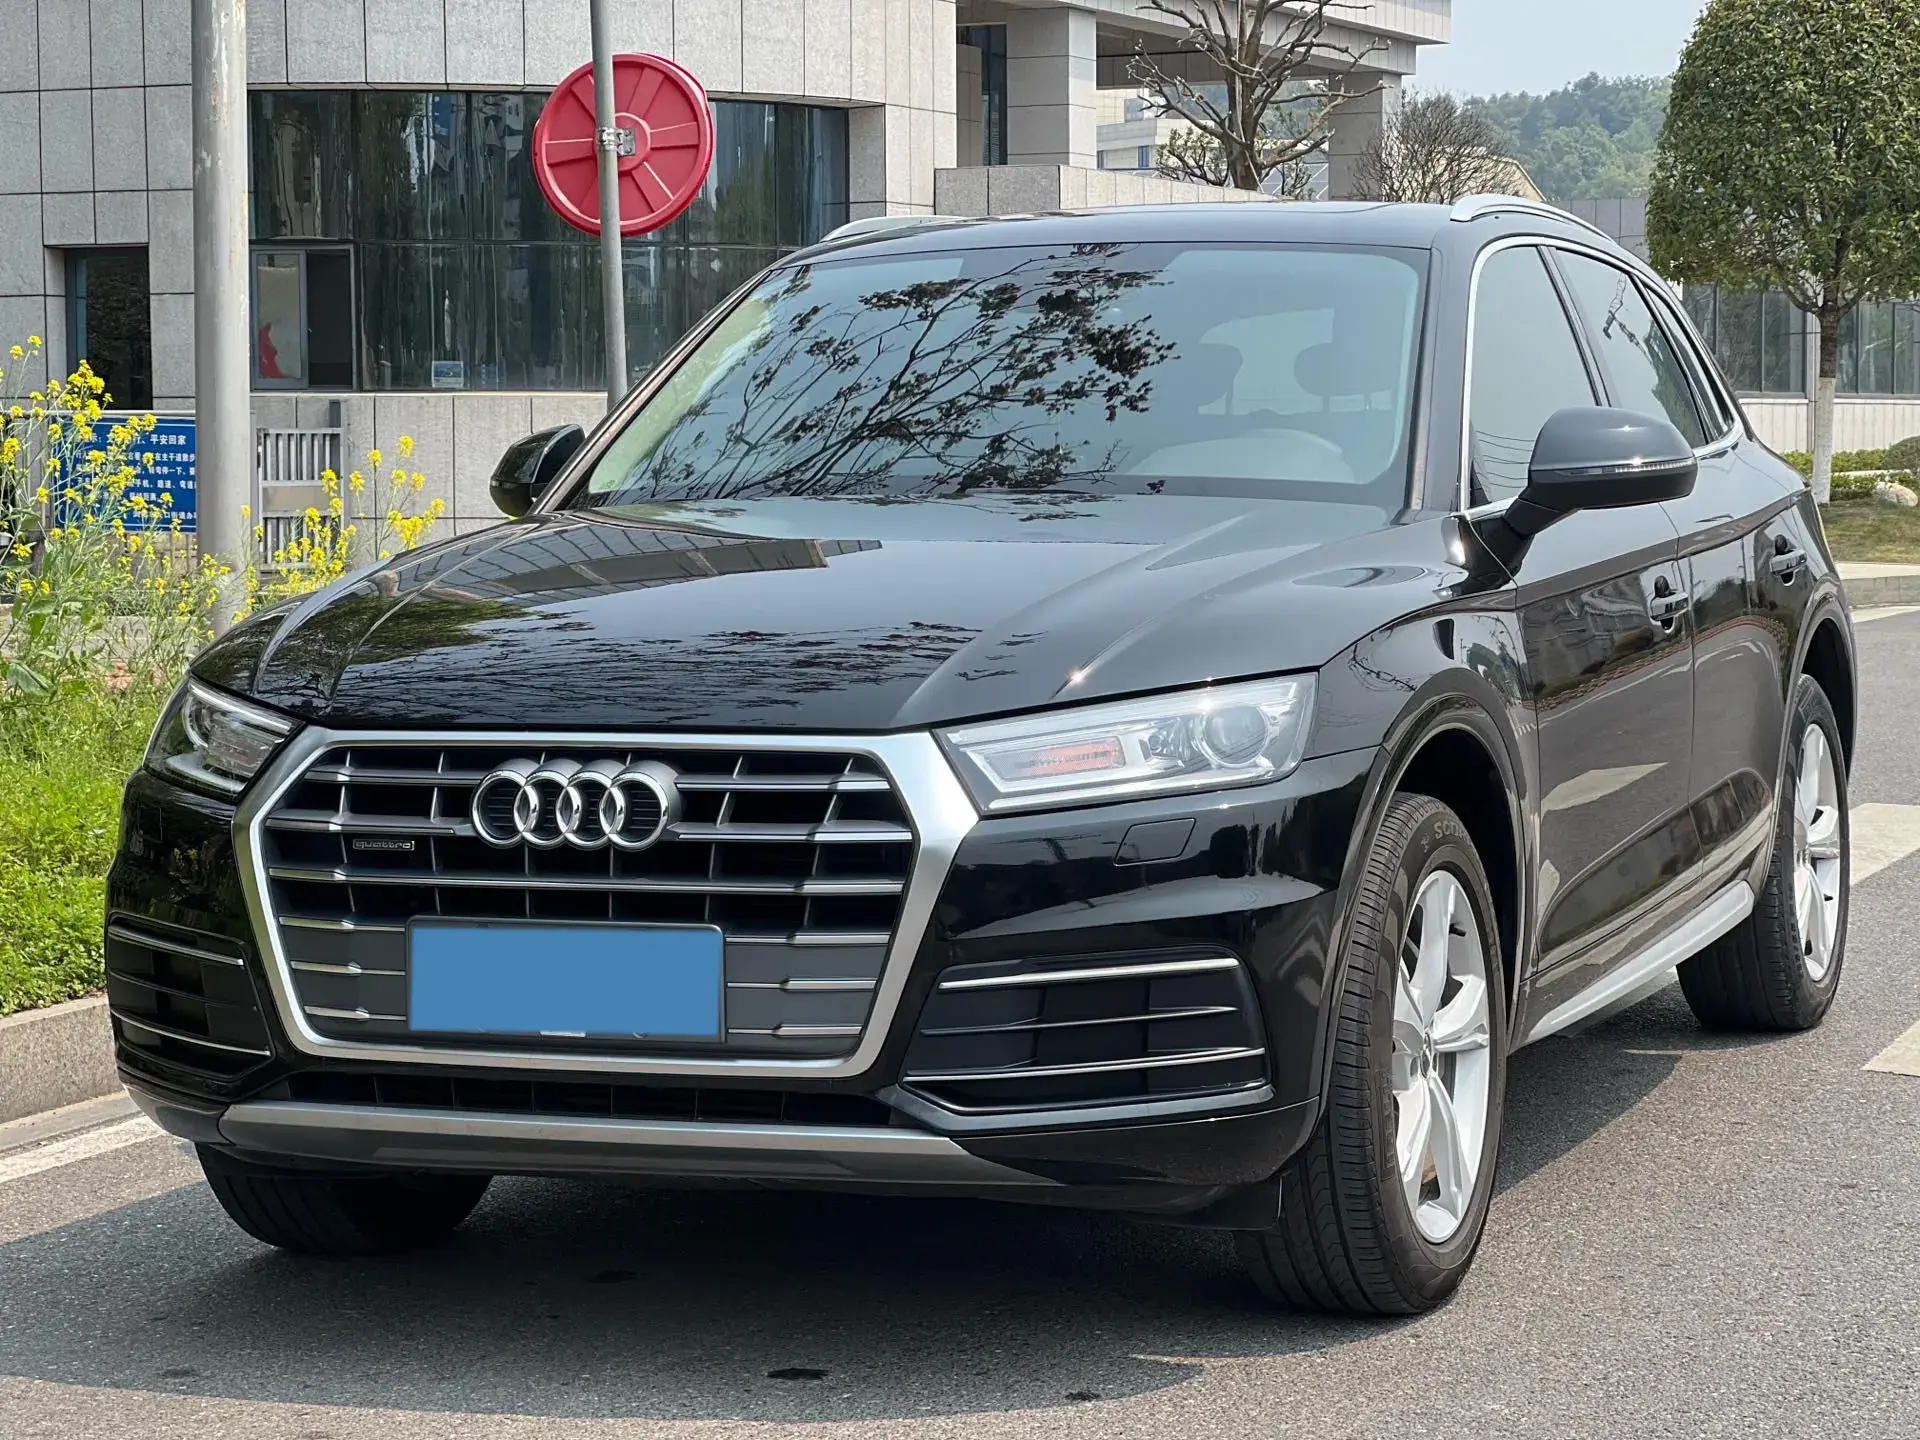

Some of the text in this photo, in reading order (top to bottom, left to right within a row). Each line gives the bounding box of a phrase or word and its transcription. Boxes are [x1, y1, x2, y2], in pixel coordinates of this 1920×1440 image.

[150, 434, 186, 445] 平安回家
[354, 840, 412, 850] quattro
